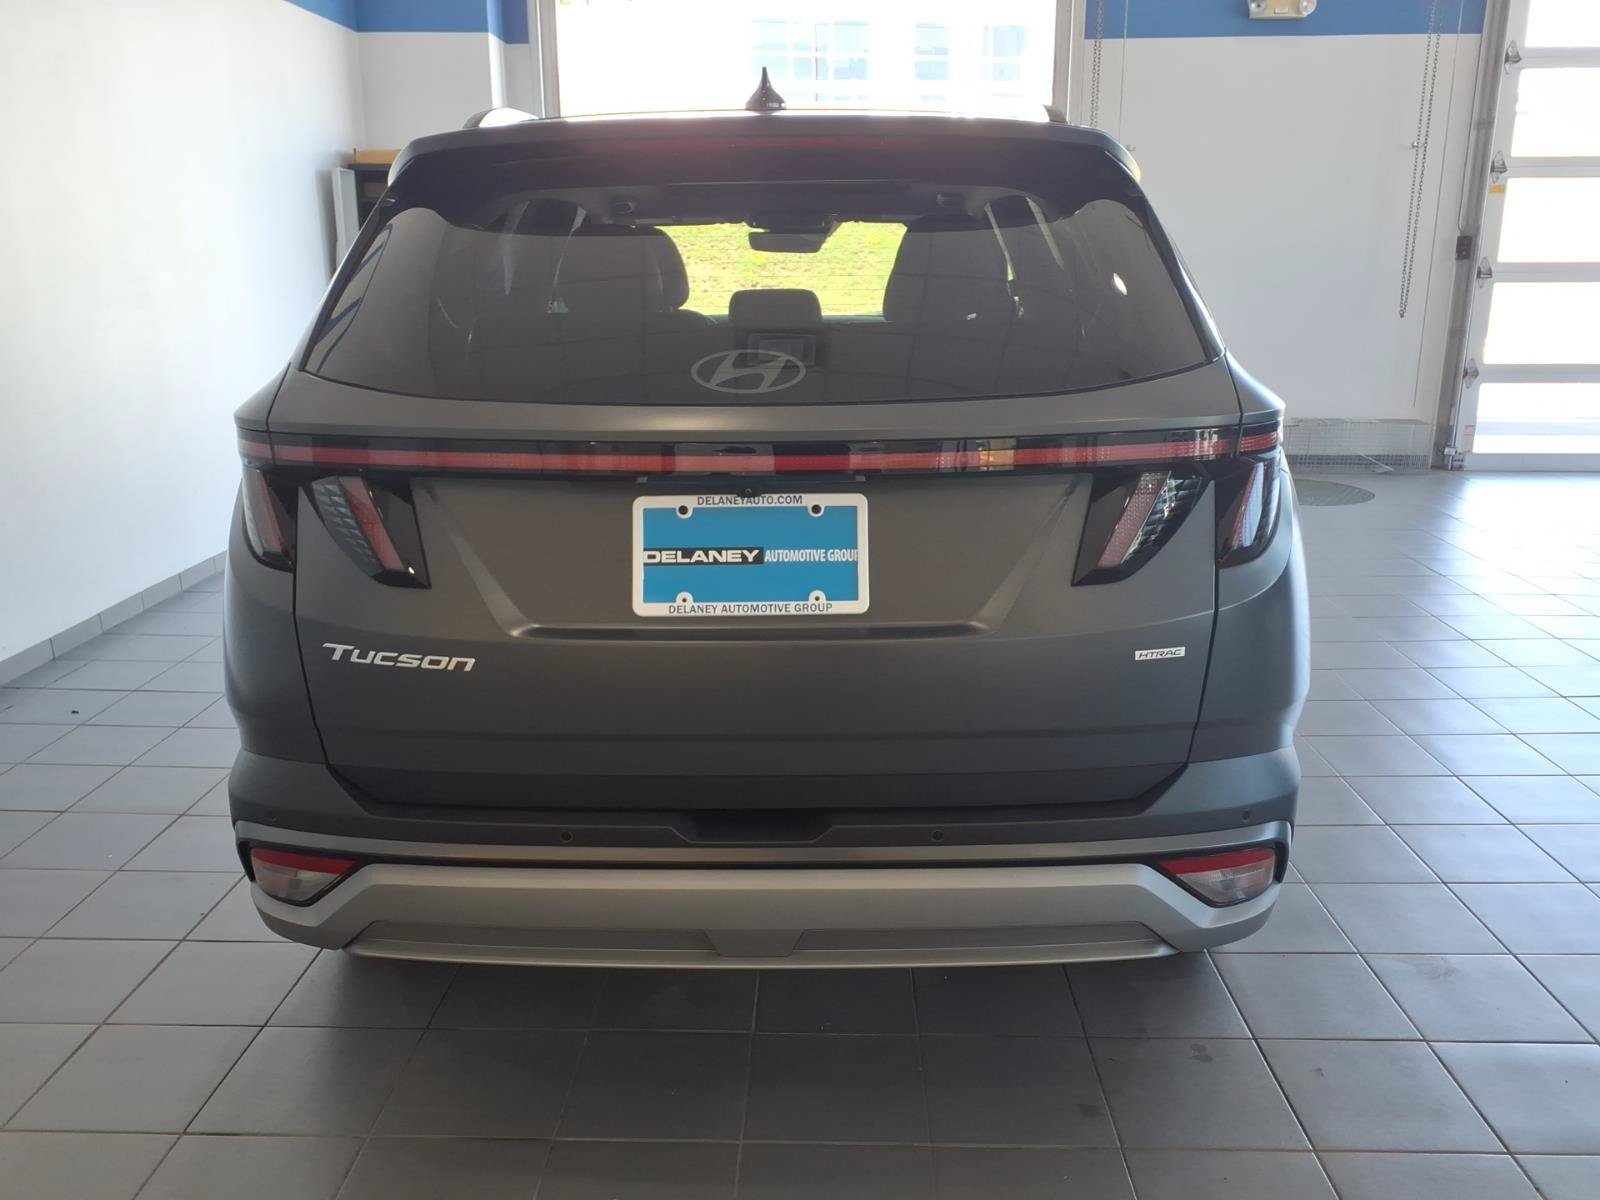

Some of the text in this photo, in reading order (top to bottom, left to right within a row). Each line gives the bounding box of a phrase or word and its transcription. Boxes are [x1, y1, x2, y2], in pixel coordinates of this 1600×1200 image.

[697, 495, 802, 505] DELANEYAUTO.COM
[643, 549, 760, 563] DELANEY
[764, 549, 826, 562] AUTOMOTIVE
[668, 603, 833, 614] DELANEY AUTOMOTIVE GROUP
[1138, 649, 1182, 658] HTRAC
